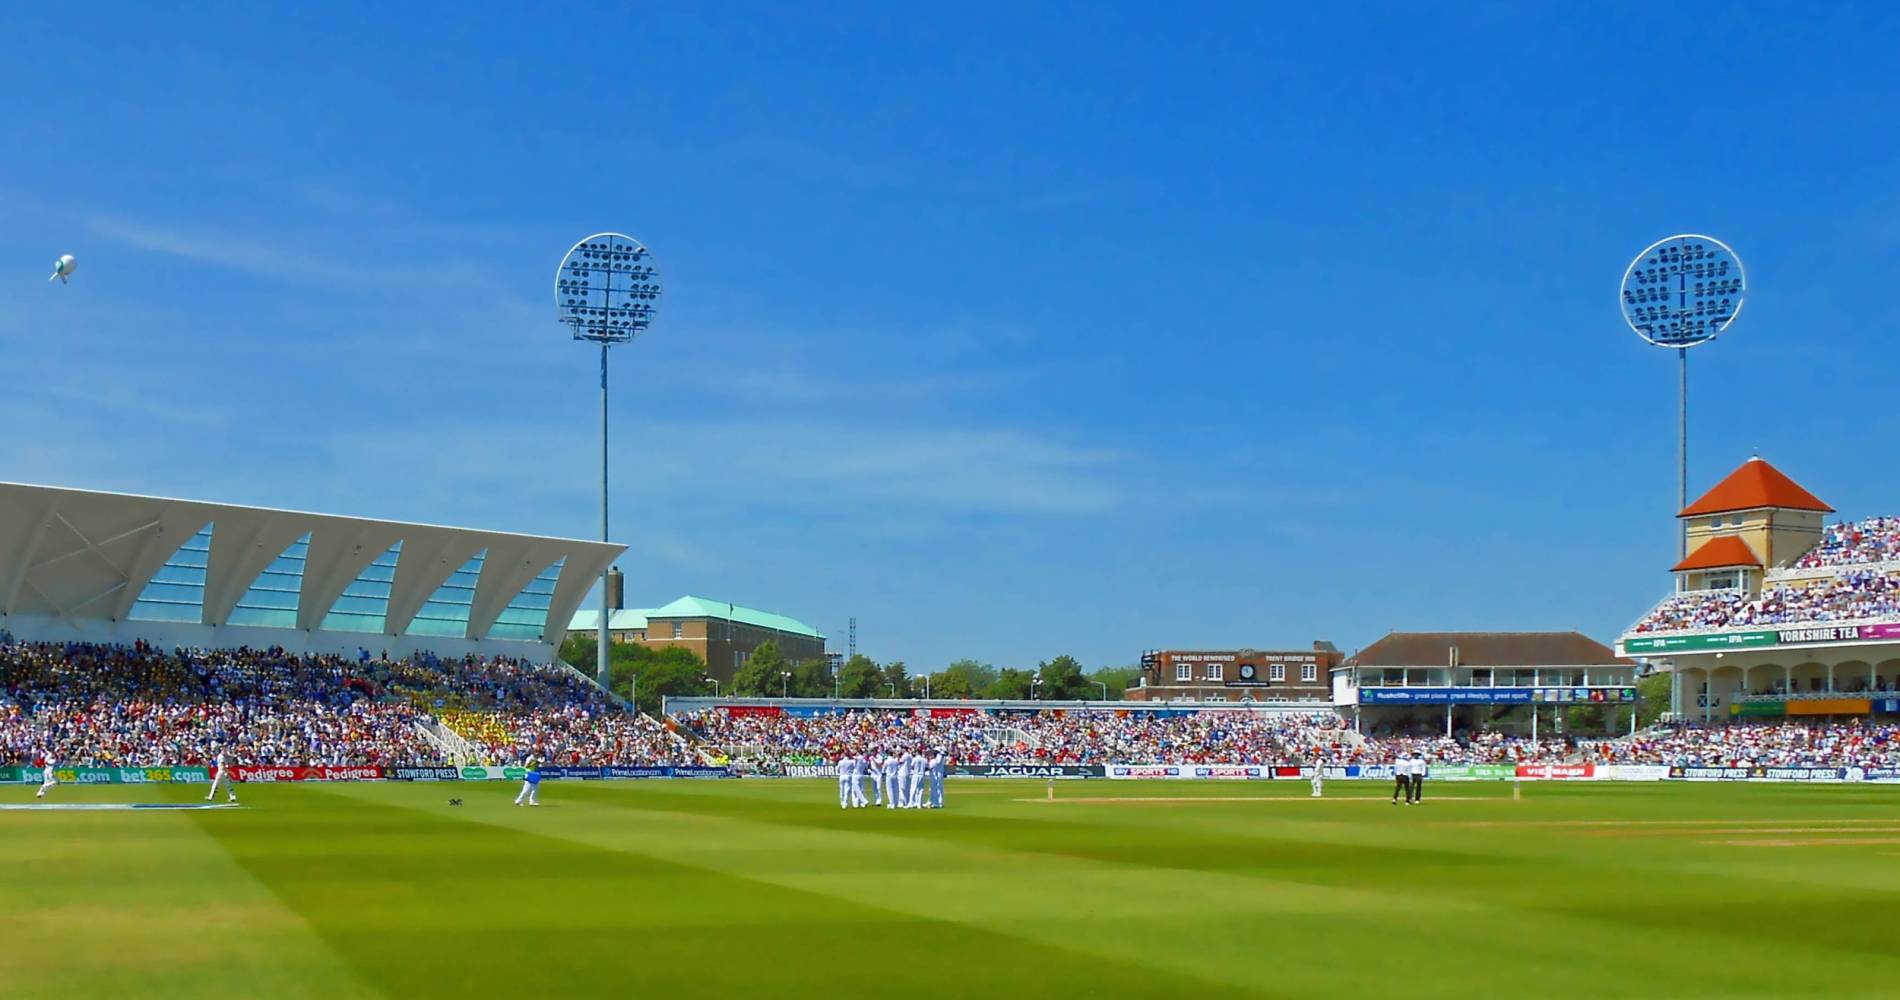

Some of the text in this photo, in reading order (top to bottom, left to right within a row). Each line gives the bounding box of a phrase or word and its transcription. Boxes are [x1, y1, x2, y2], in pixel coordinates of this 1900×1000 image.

[1779, 627, 1859, 642] YORKSHIRE TEA
[120, 769, 205, 782] bet365.com
[239, 768, 294, 780] Pedigree
[325, 768, 378, 780] Pedigree
[396, 768, 434, 778] STOWFORD
[435, 768, 457, 778] PRESS
[984, 767, 1064, 776] JAGUAR
[1359, 764, 1396, 777] Kwik
[1683, 768, 1748, 778] STOWFORD PRESS
[1766, 769, 1837, 779] STOWFORD PRESS
